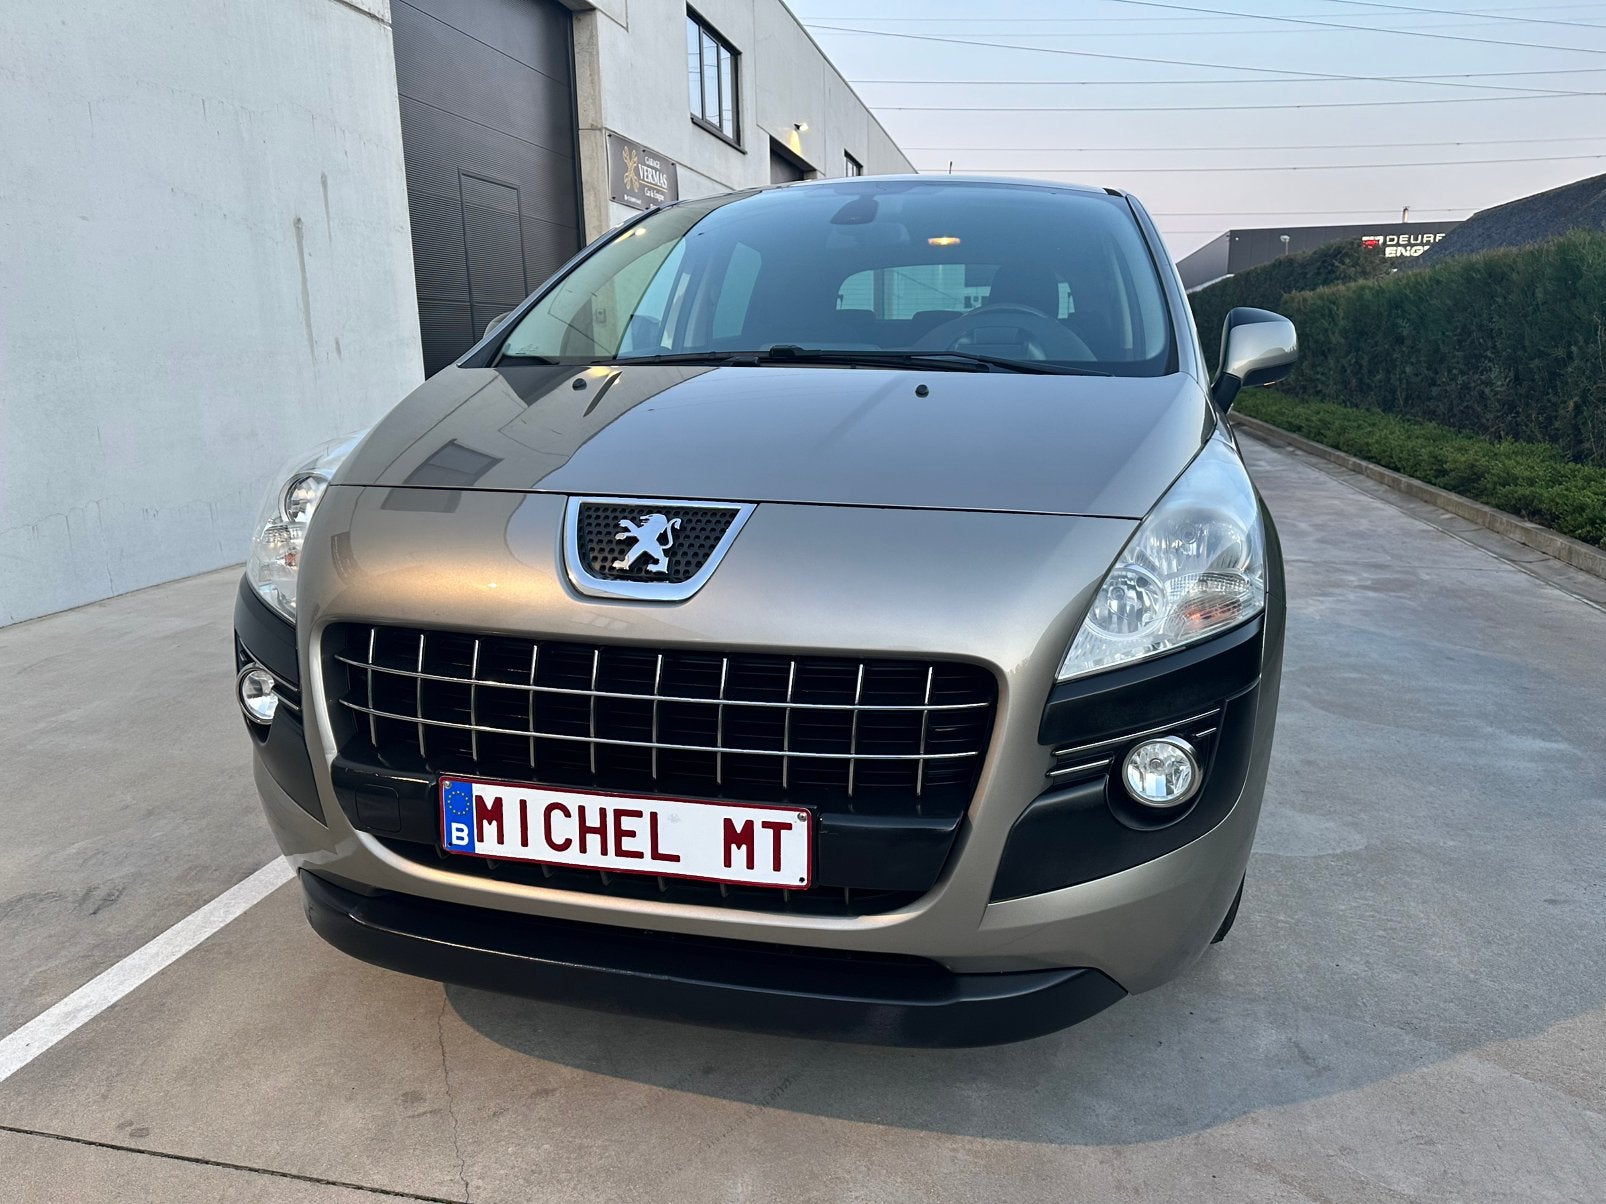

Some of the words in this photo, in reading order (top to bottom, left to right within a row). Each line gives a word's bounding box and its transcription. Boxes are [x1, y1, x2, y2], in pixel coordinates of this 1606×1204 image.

[638, 164, 668, 188] VERMAS
[451, 822, 469, 846] B
[475, 794, 681, 863] MICHEL
[723, 817, 793, 872] MT
